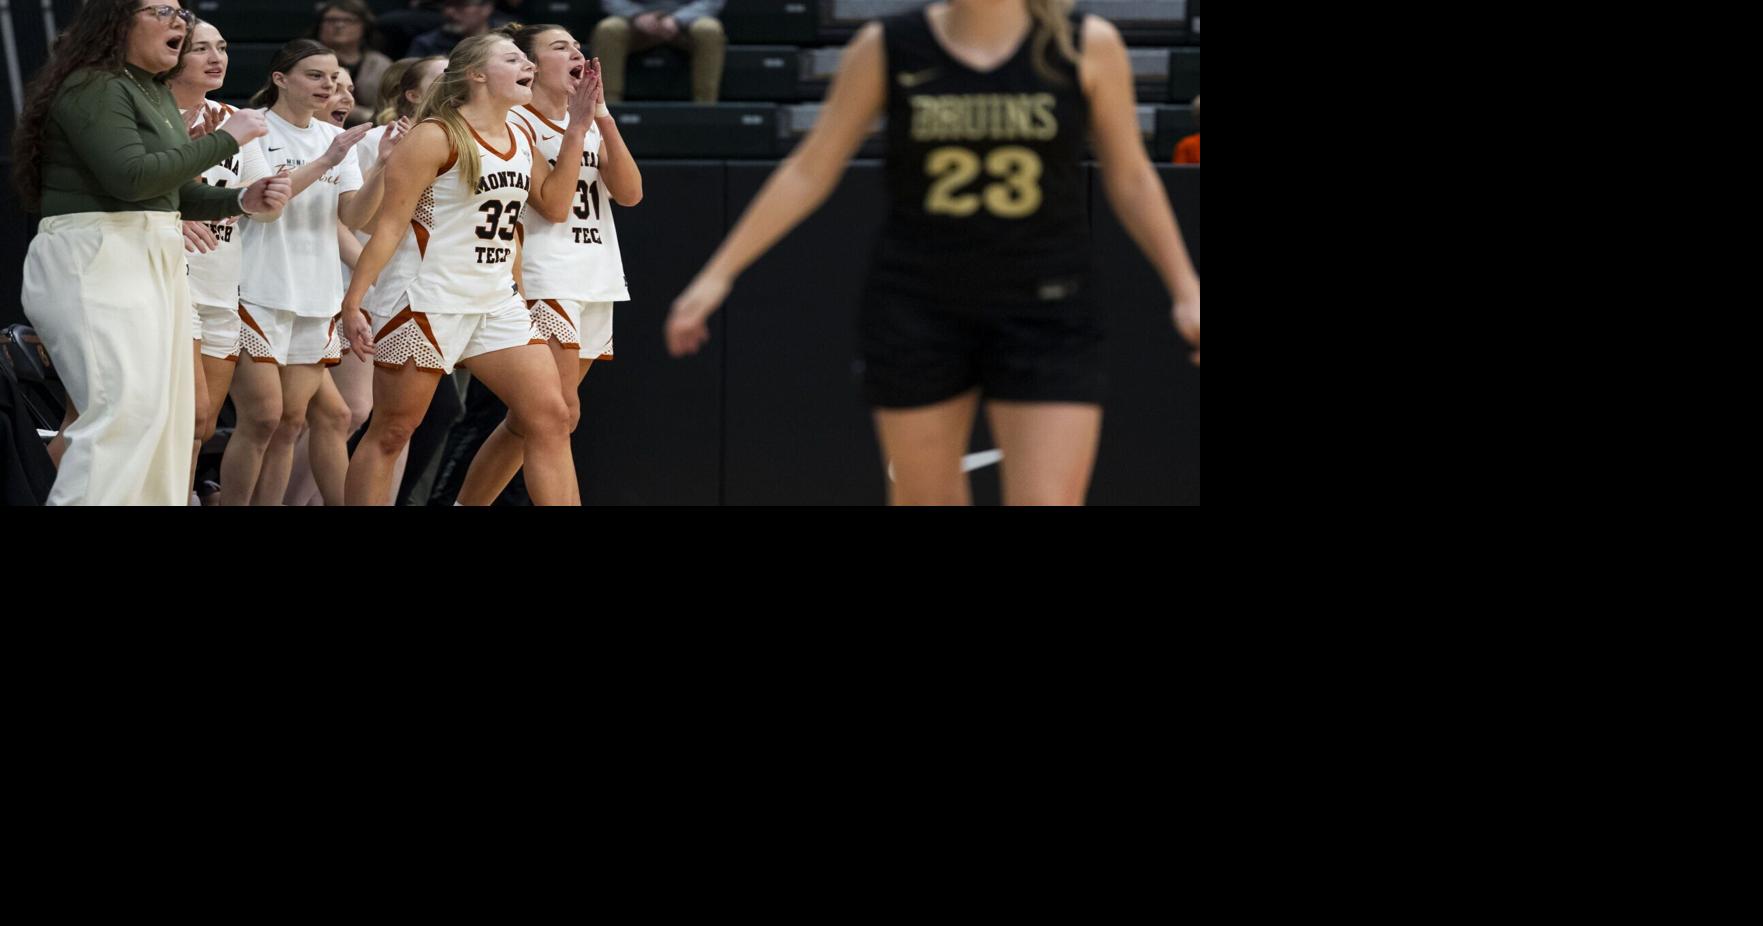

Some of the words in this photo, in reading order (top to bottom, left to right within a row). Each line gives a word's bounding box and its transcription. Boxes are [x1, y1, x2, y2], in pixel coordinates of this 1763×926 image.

[910, 93, 1058, 141] BRUINS
[573, 179, 600, 220] 31
[925, 147, 1043, 217] 23
[475, 199, 522, 241] 33
